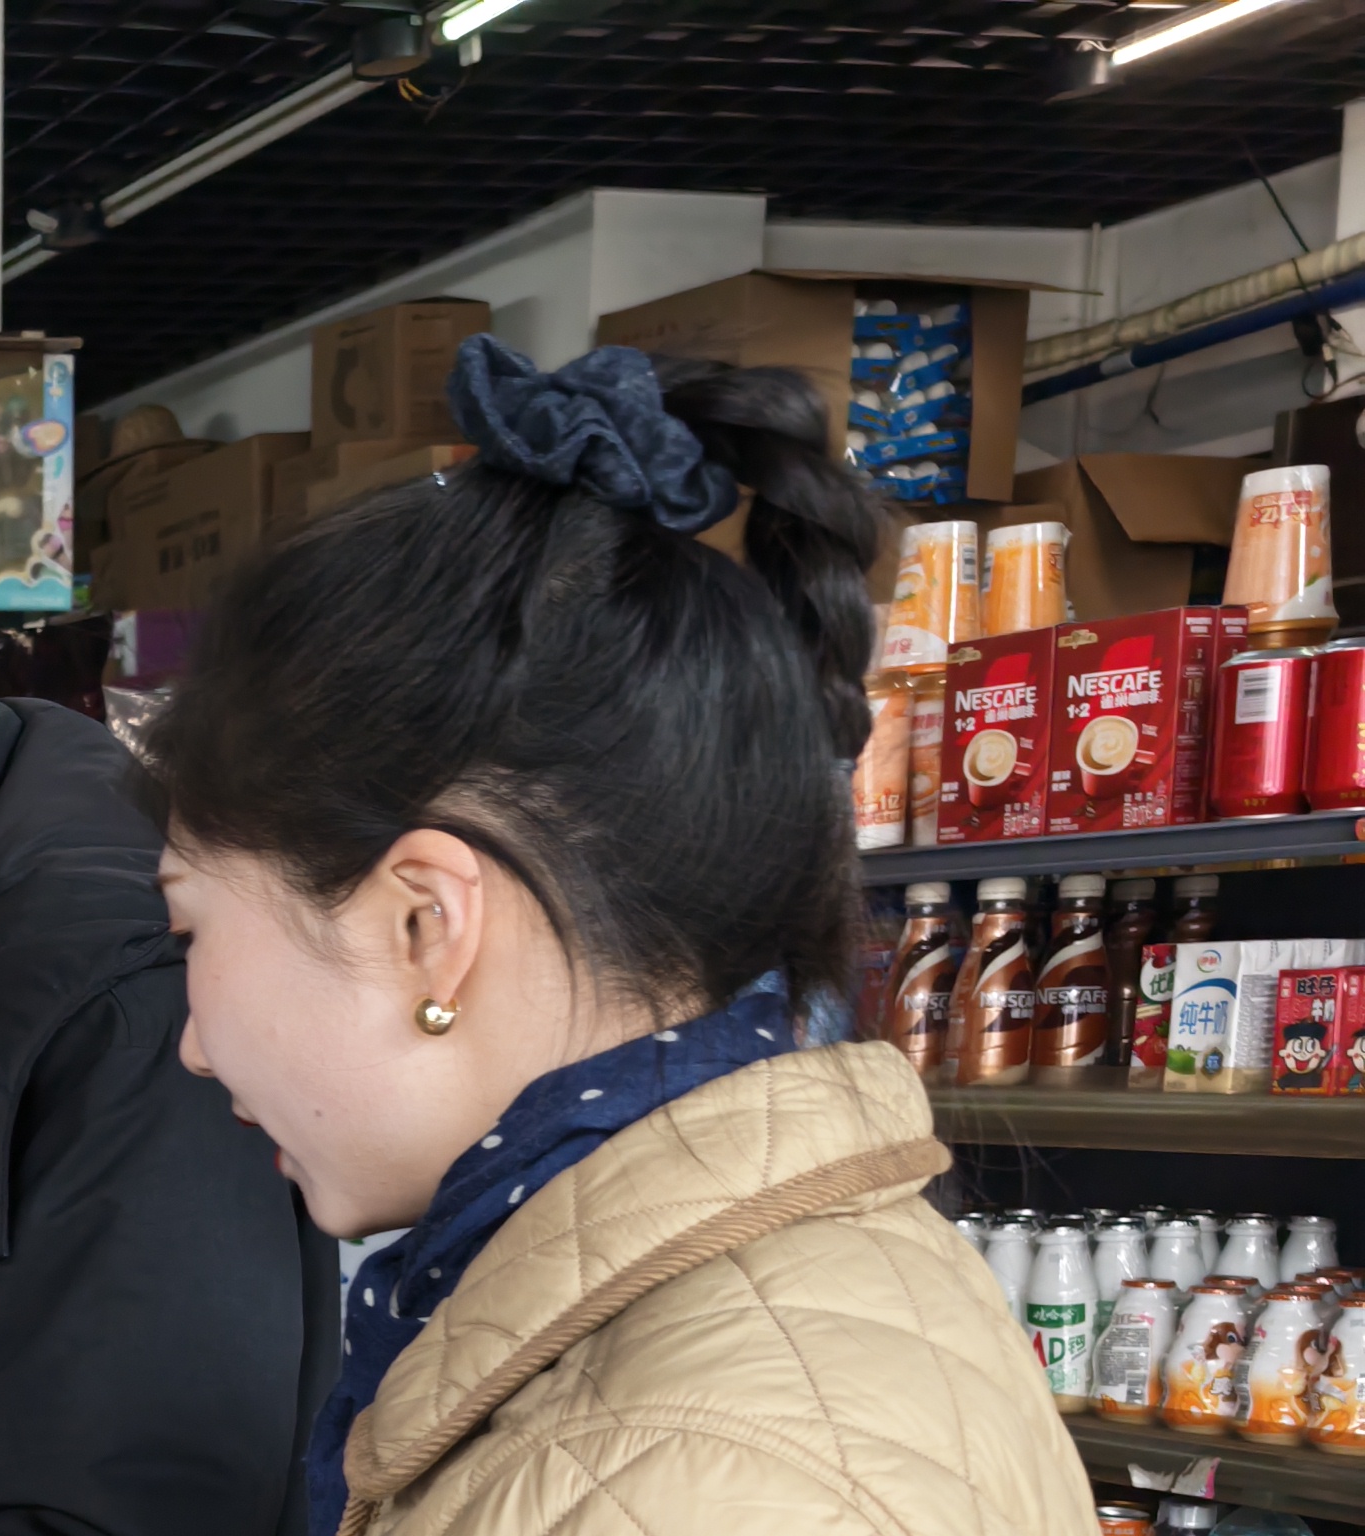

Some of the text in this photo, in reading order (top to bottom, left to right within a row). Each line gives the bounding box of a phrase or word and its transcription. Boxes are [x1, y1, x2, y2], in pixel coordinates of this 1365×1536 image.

[1296, 974, 1336, 997] 旺仔
[1178, 1001, 1229, 1036] 纯牛奶
[1312, 998, 1335, 1022] 牛奶
